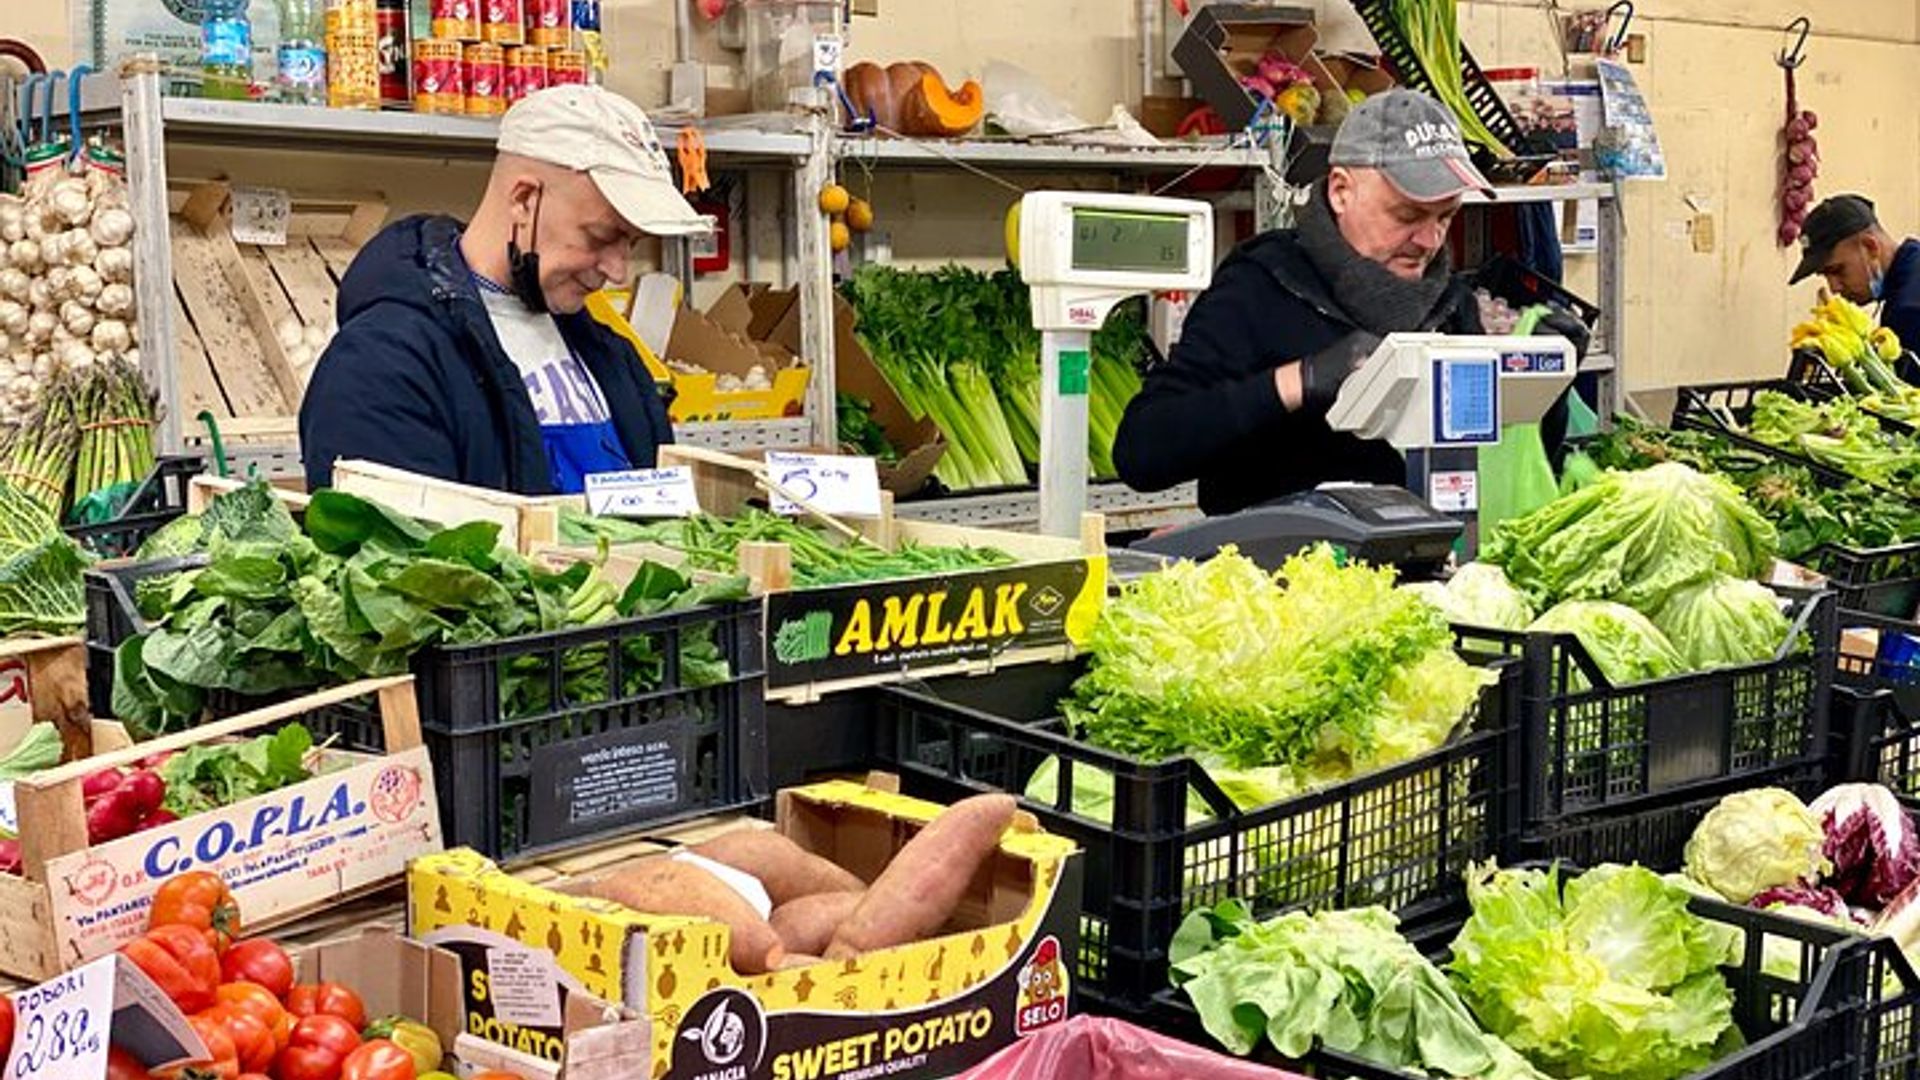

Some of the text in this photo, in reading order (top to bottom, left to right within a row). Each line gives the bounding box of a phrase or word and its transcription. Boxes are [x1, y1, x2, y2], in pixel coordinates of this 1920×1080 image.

[835, 582, 1027, 655] AMLAK
[469, 1012, 563, 1062] POTATO
[1022, 1002, 1060, 1028] SELO
[773, 1007, 993, 1080] SWEET POTATO
[886, 1054, 928, 1075] QUALITY
